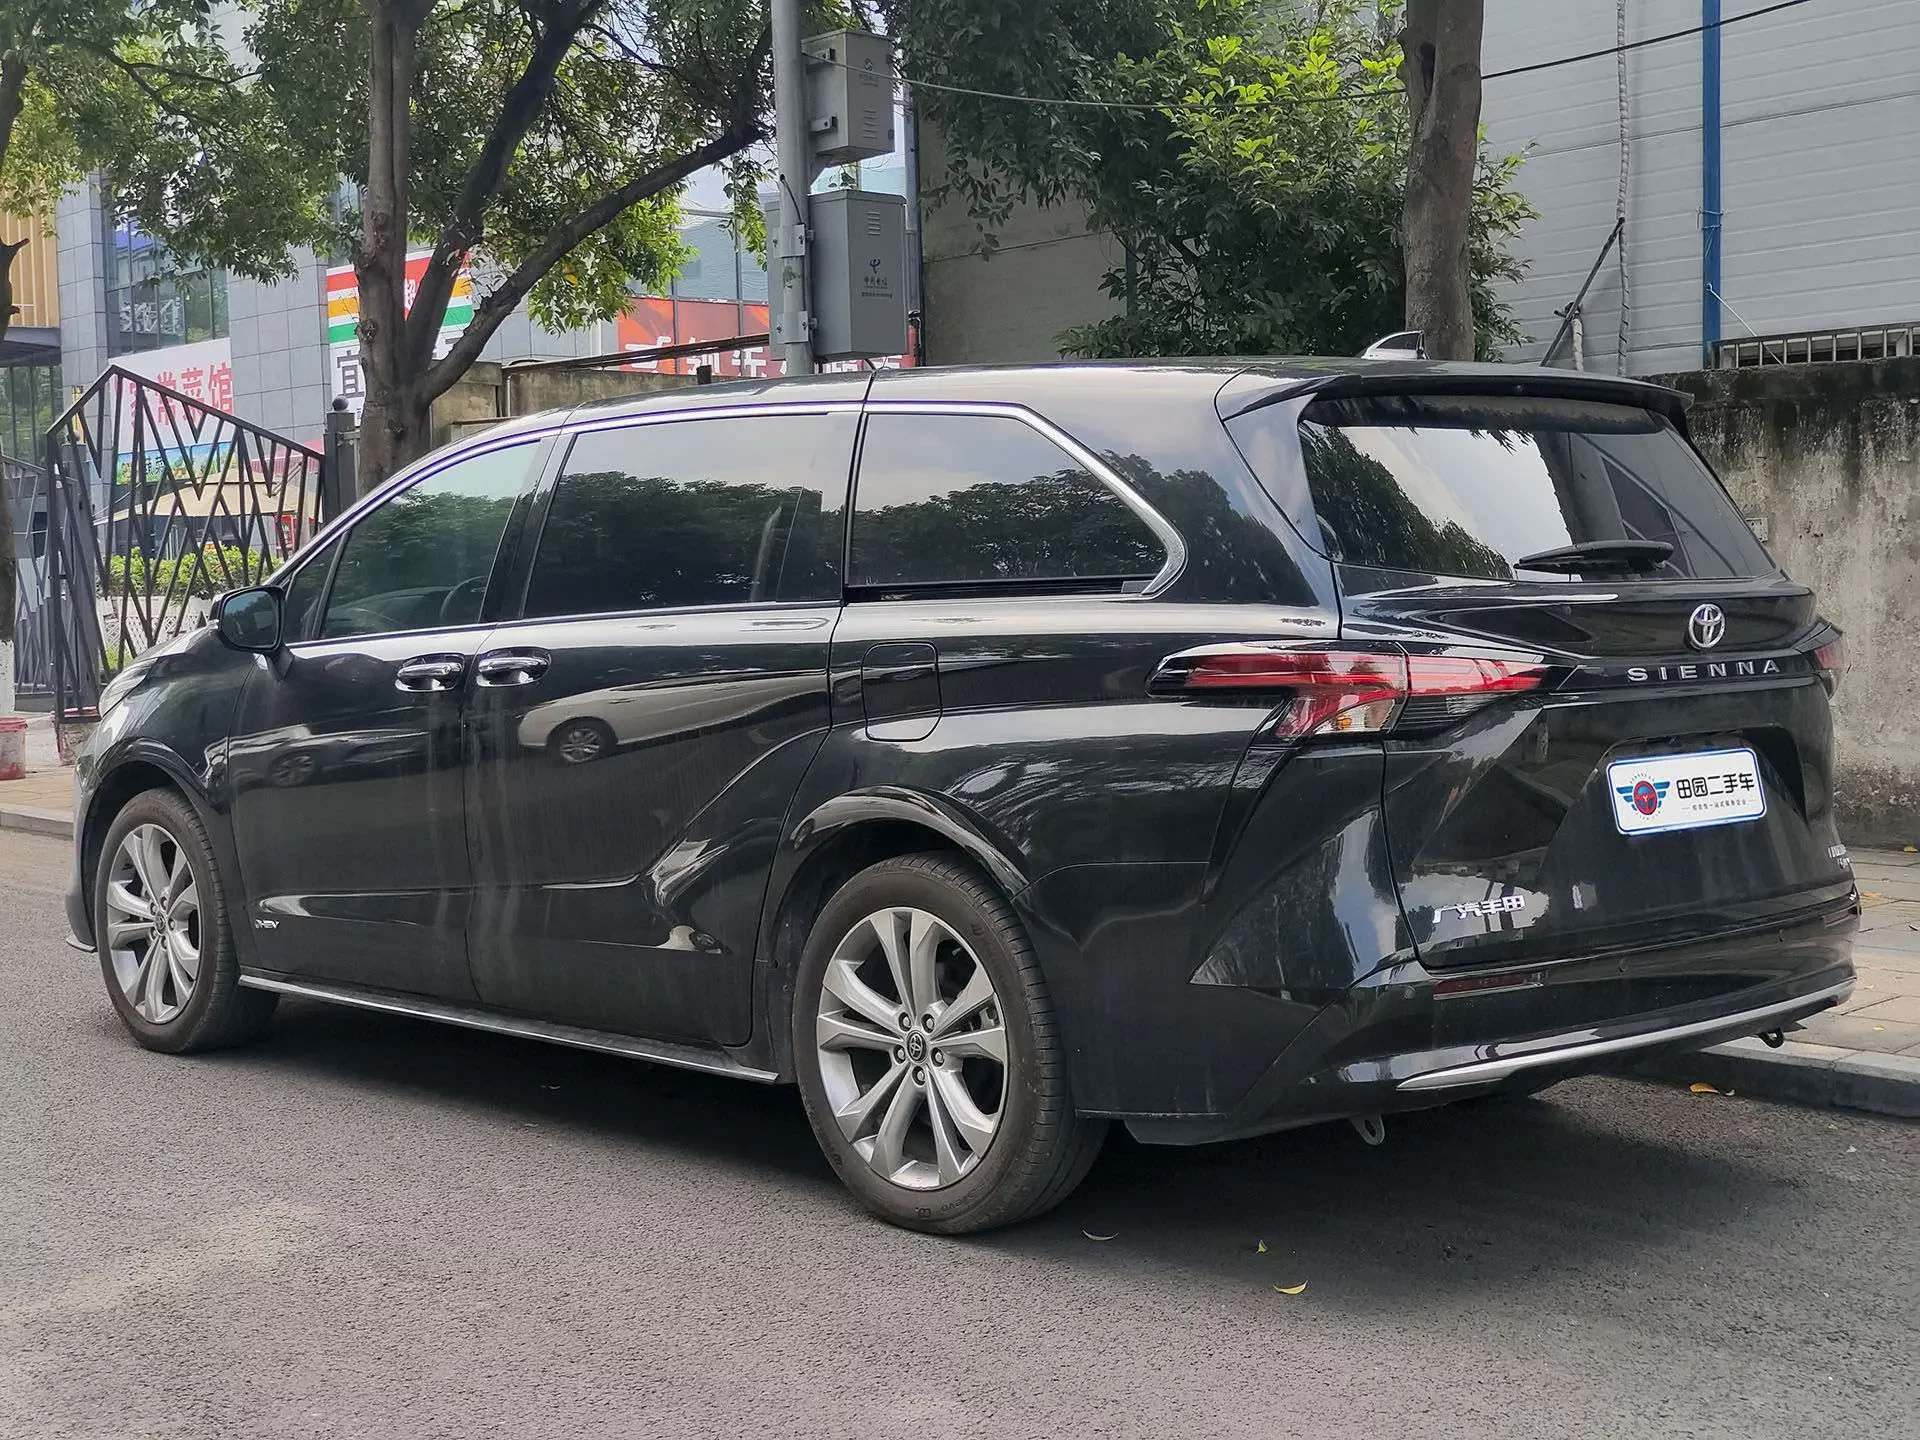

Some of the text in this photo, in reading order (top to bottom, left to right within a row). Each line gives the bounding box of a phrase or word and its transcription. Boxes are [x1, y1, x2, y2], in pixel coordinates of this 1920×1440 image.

[1627, 659, 1780, 682] SIENNA
[1676, 772, 1755, 799] 田园二手车
[1432, 895, 1526, 924] 广汽丰田
